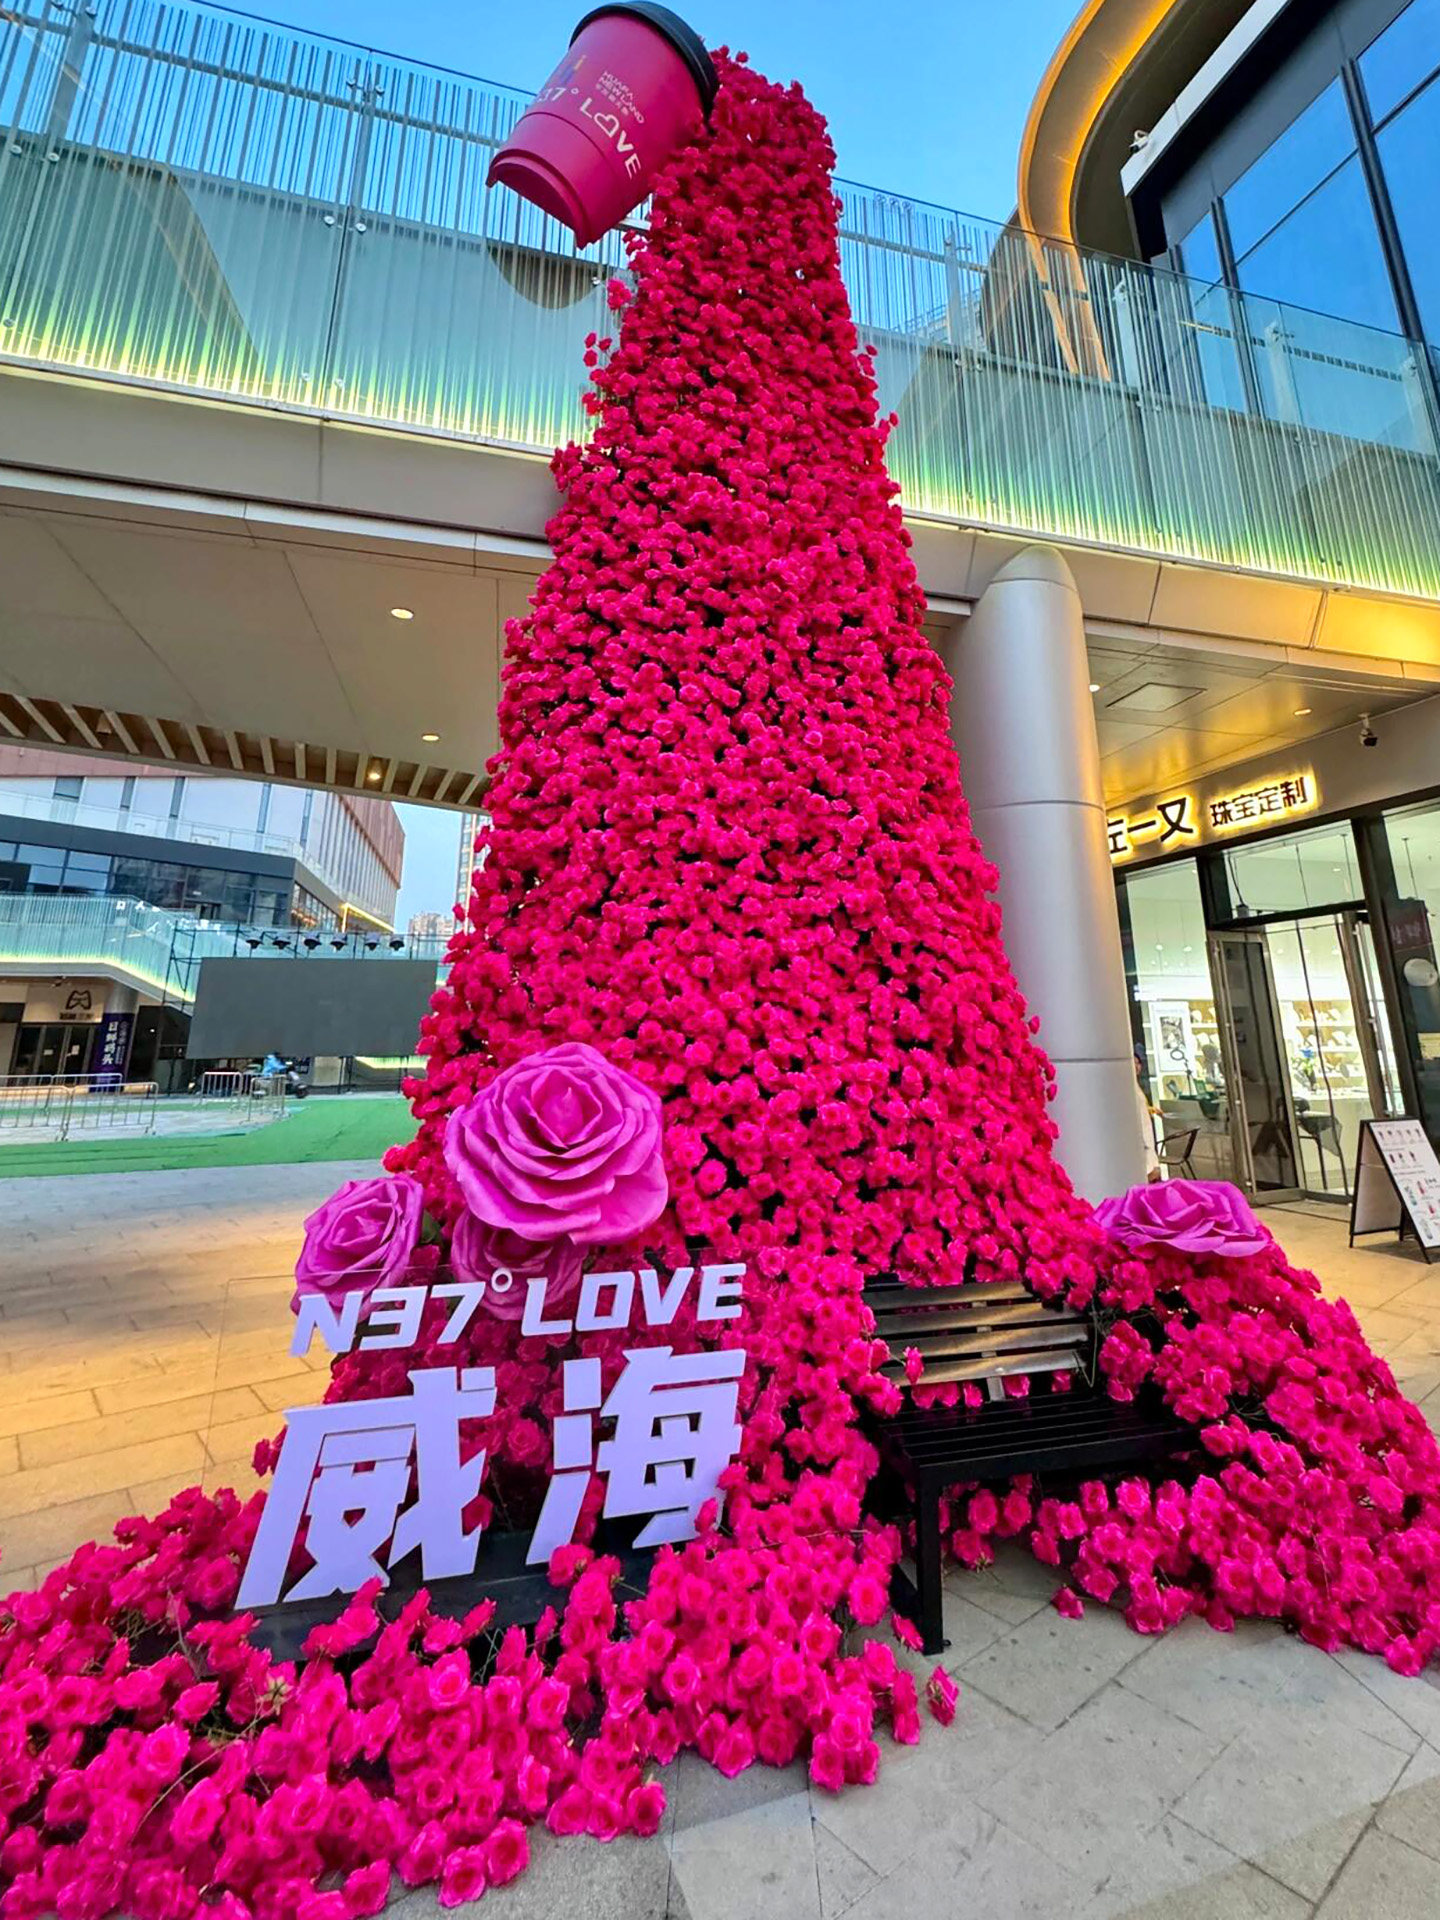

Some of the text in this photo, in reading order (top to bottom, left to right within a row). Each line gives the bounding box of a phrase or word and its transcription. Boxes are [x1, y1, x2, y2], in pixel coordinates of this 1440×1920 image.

[1209, 776, 1309, 828] 珠宝定制
[521, 1262, 747, 1338] LOVE
[234, 1345, 747, 1611] 威海
